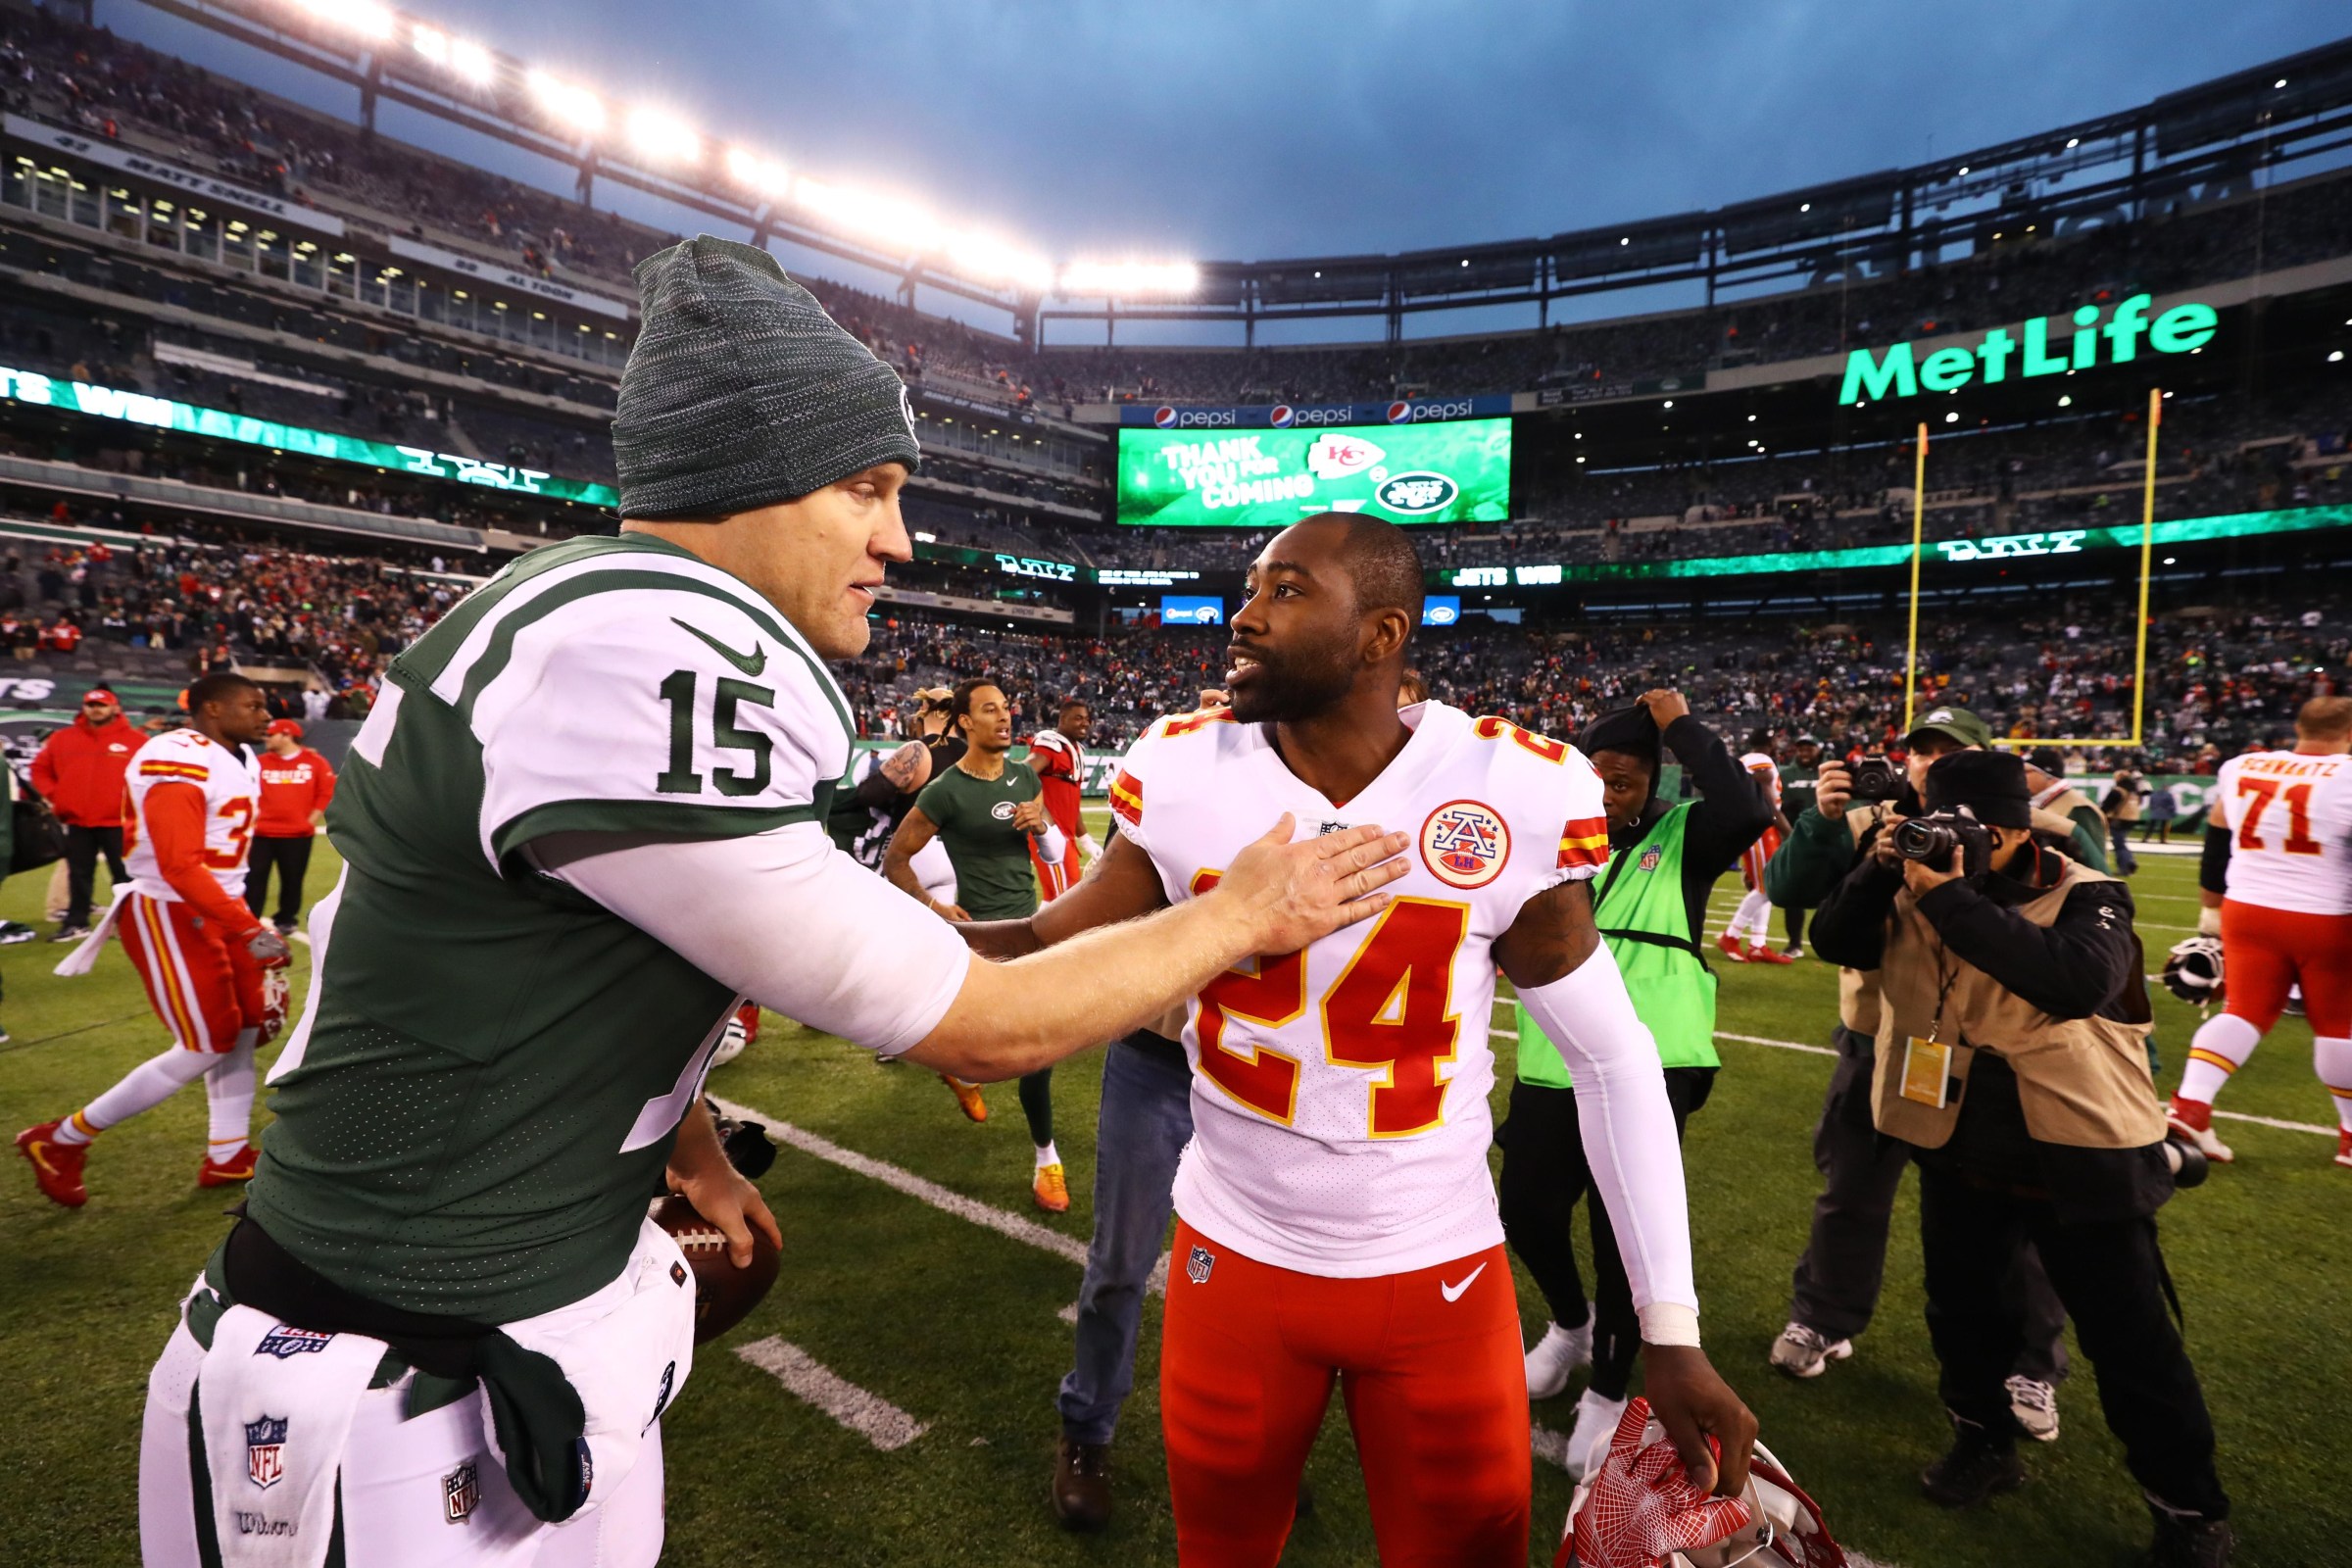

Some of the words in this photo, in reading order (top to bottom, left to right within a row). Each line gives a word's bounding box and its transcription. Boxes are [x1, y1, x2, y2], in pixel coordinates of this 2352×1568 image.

[1838, 292, 2219, 405] MetLife
[1180, 409, 1237, 428] pepsi
[1295, 405, 1352, 425] pepsi
[1412, 399, 1473, 422] pepsi
[1161, 435, 1263, 470] THANK
[1327, 446, 1365, 466] KC
[1178, 462, 1237, 490] YOU
[1239, 457, 1280, 477] FOR
[1451, 566, 1508, 587] JETS
[1515, 564, 1562, 586] WIN
[656, 668, 775, 798] 15
[2237, 775, 2323, 857] 71
[1454, 855, 1475, 870] LH
[1192, 867, 1471, 1140] 24
[1190, 1257, 1206, 1279] NFL
[250, 1446, 282, 1483] NFL
[450, 1485, 477, 1515] NFL
